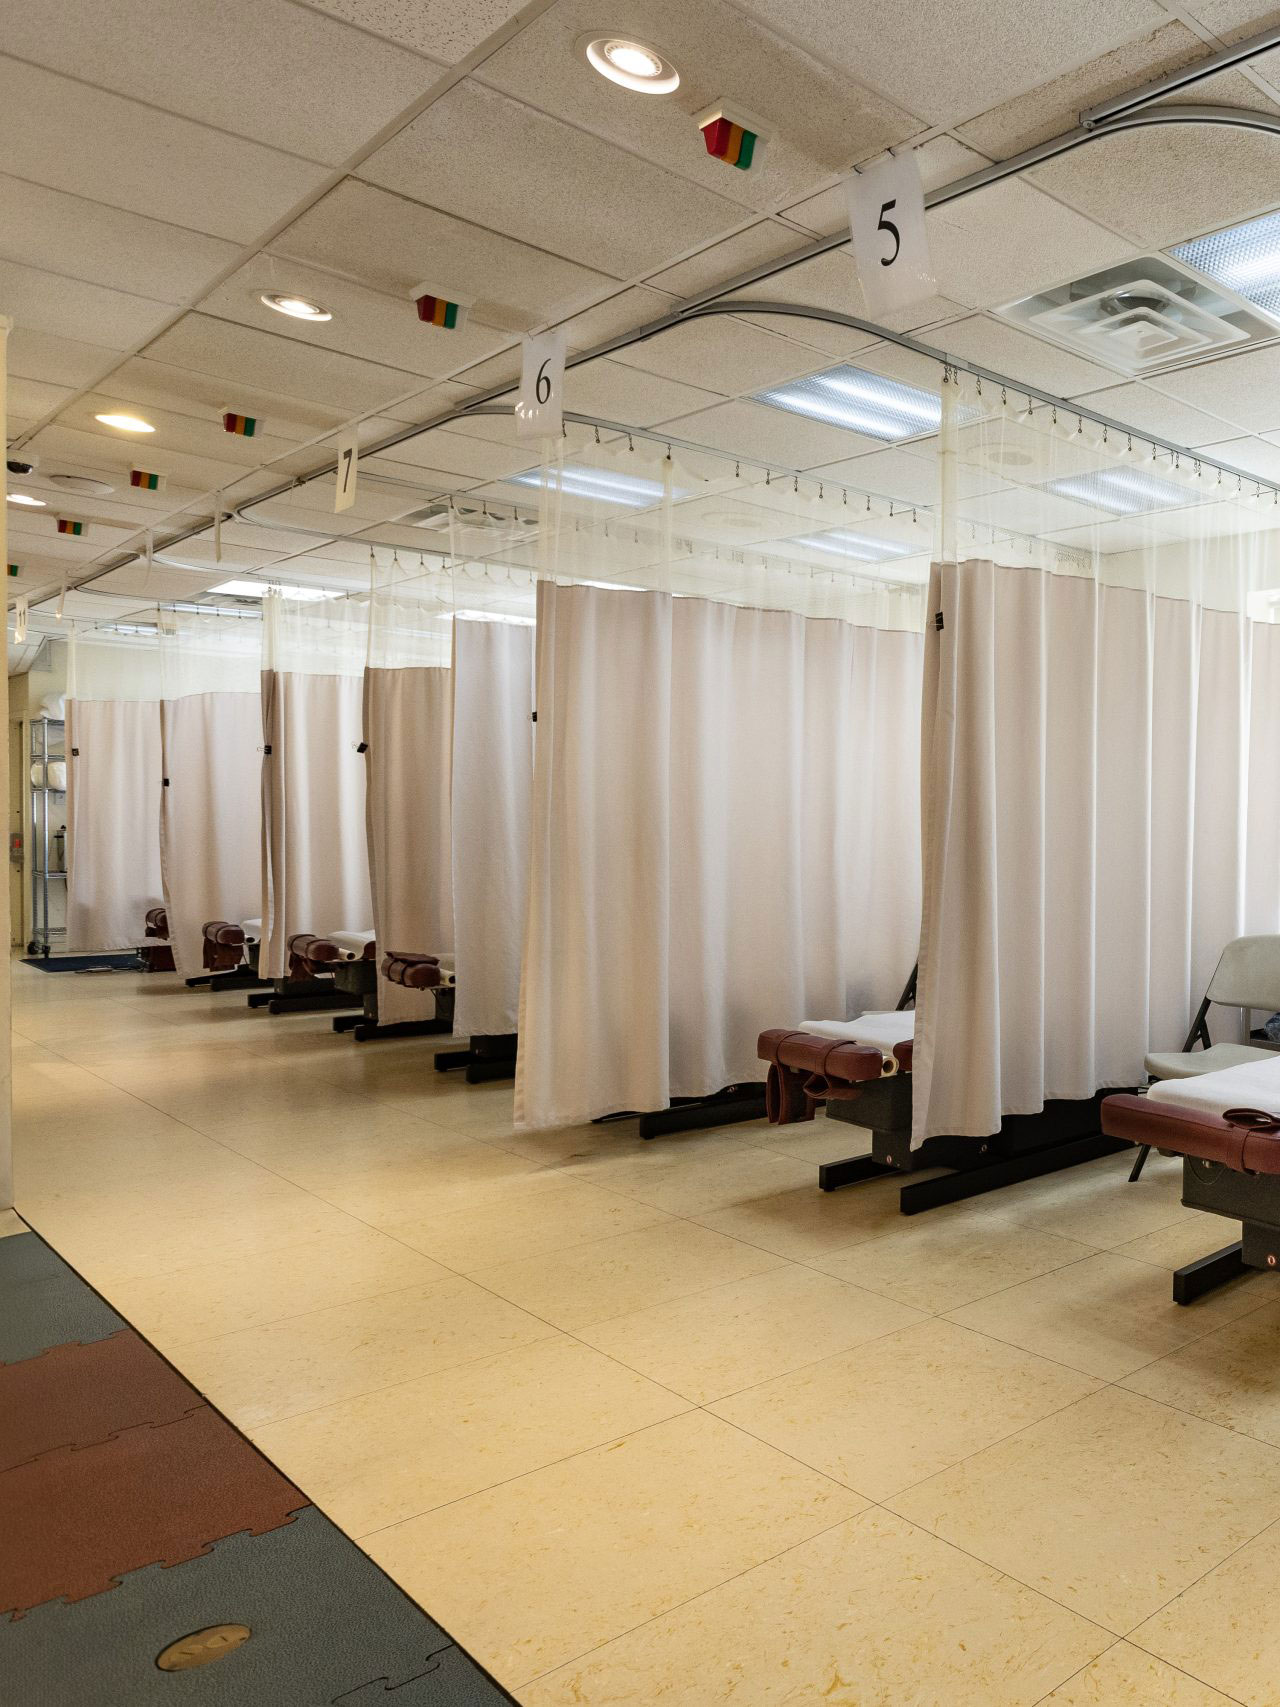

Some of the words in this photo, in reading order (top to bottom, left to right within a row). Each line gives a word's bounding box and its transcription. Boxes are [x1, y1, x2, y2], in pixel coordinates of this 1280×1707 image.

[877, 198, 900, 267] 5
[535, 358, 552, 405] 6
[343, 447, 353, 493] 7
